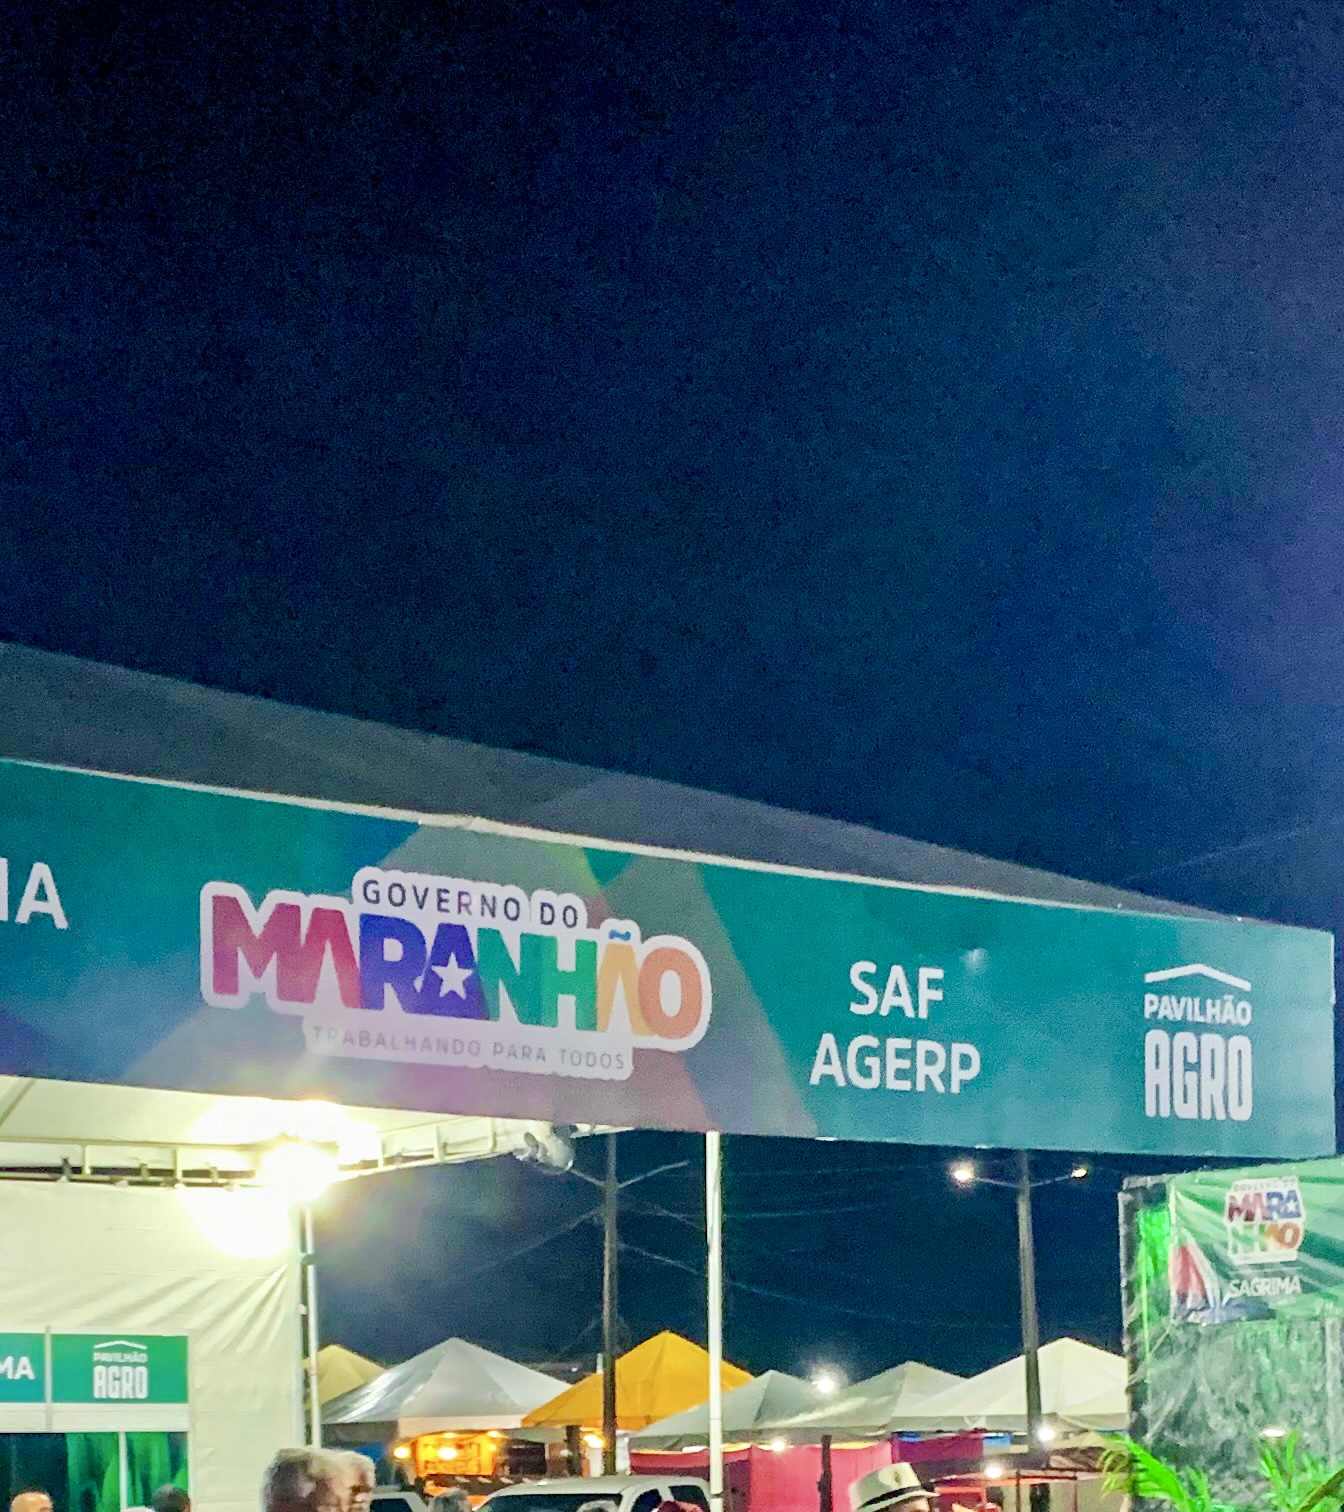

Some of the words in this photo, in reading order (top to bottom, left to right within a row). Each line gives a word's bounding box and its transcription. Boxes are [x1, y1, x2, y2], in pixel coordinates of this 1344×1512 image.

[362, 879, 521, 921] GOVERNO
[539, 900, 579, 929] DO
[211, 895, 703, 1040] MARANHÃO
[849, 961, 945, 1018] SAF
[1144, 994, 1252, 1026] PAVILHÃO
[312, 1025, 481, 1057] TRABALHANDO
[492, 1042, 547, 1063] PARA
[559, 1048, 627, 1071] TODOS
[809, 1032, 981, 1094] AGERP
[1145, 1031, 1253, 1121] AGRO
[1227, 1189, 1303, 1222] MARA
[1229, 1275, 1303, 1298] SAGRIMA
[93, 1365, 149, 1400] AGRO
